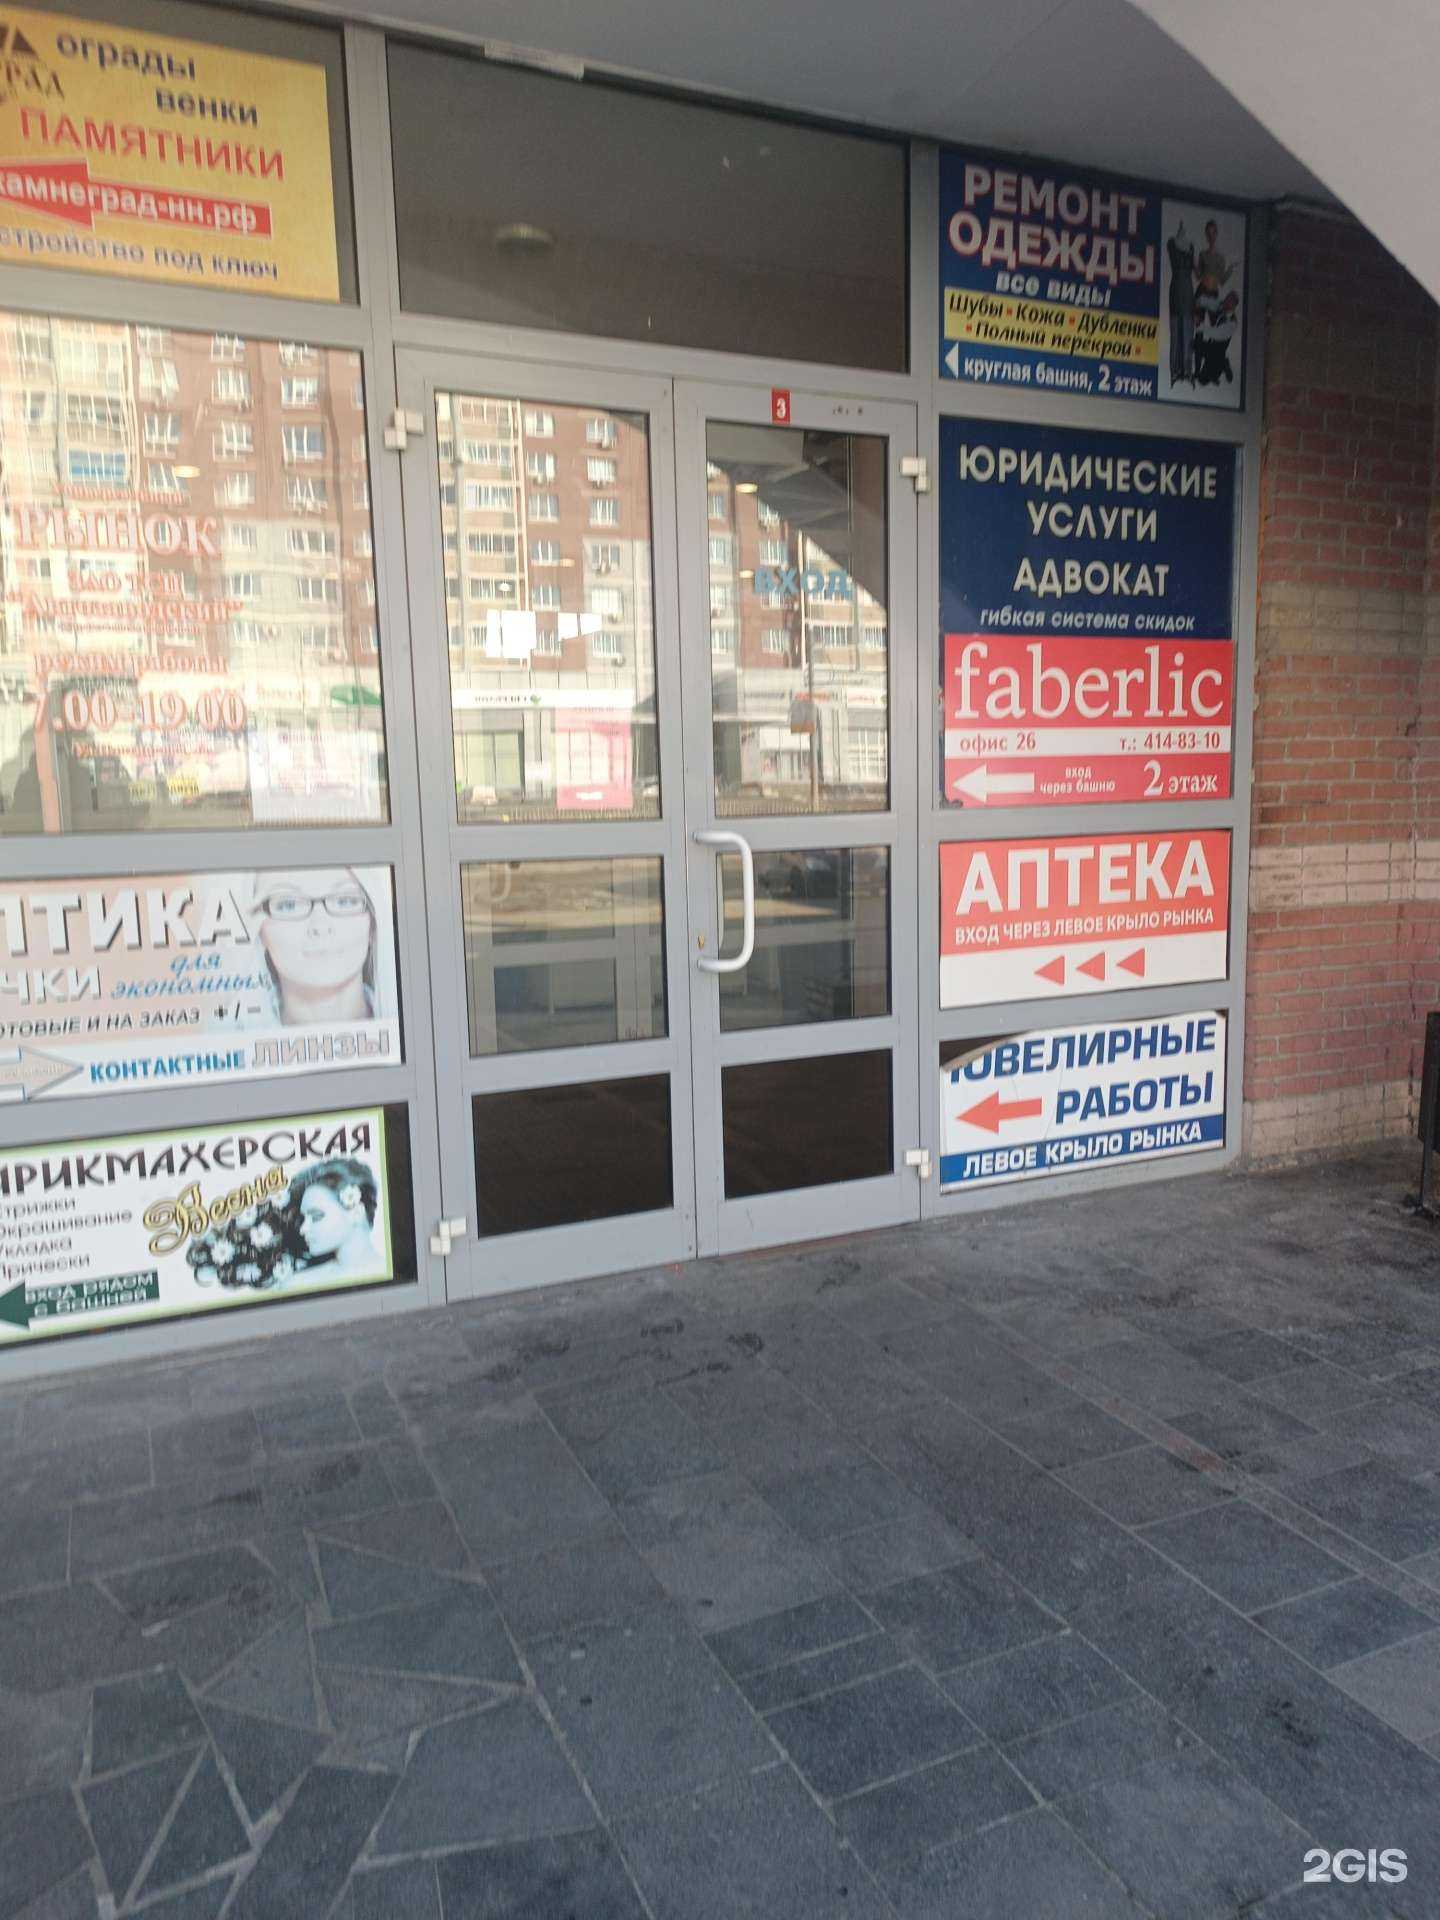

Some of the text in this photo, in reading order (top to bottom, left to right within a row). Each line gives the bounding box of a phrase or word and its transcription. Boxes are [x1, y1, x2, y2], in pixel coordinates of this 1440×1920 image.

[56, 32, 196, 81] ограды
[0, 58, 65, 101] РАД
[155, 88, 259, 128] венки
[19, 106, 285, 182] ПАМЯТНИКИ
[964, 162, 1146, 235] РЕМОНТ
[154, 243, 204, 275] под
[212, 252, 278, 281] ключ
[949, 209, 1155, 286] ОДЕЖДЫ
[949, 293, 1003, 319] Шубы
[1015, 302, 1065, 327] Кожа
[996, 272, 1112, 308] все виды
[975, 323, 1132, 359] Полный перекрой
[964, 357, 1153, 397] круглая башня, 2 этаж
[959, 443, 1217, 499] ЮРИДИЧЕСКИЕ
[1026, 500, 1157, 543] УСЛУГИ
[1012, 557, 1170, 599] АДВОКАТ
[980, 605, 1195, 633] гибкая система скидок
[954, 640, 1224, 719] faberlic
[960, 732, 1037, 757] офис 26
[1143, 731, 1221, 750] 414-83-10
[1040, 777, 1116, 796] через башню
[1064, 765, 1092, 779] вход
[1143, 759, 1217, 797] 2 этаж
[955, 838, 1215, 916] АПТЕКА
[955, 907, 1214, 946] ВХОД ЧЕРЕЗ ЛЕВОЕ КРЫЛО РЫНКА
[170, 953, 222, 977] для
[87, 1014, 100, 1034] И
[107, 1012, 132, 1032] НА
[140, 1008, 200, 1028] ЗАКАЗ
[90, 1048, 246, 1084] КОНТАКТНЫЕ
[251, 1028, 390, 1069] ЛИНЗЫ
[1055, 1071, 1214, 1125] РАБОТЫ
[962, 1121, 1202, 1179] ЛЕВОЕ КРЫЛО РЫНКА
[0, 1198, 76, 1221] трижки
[143, 1164, 289, 1257] Весна
